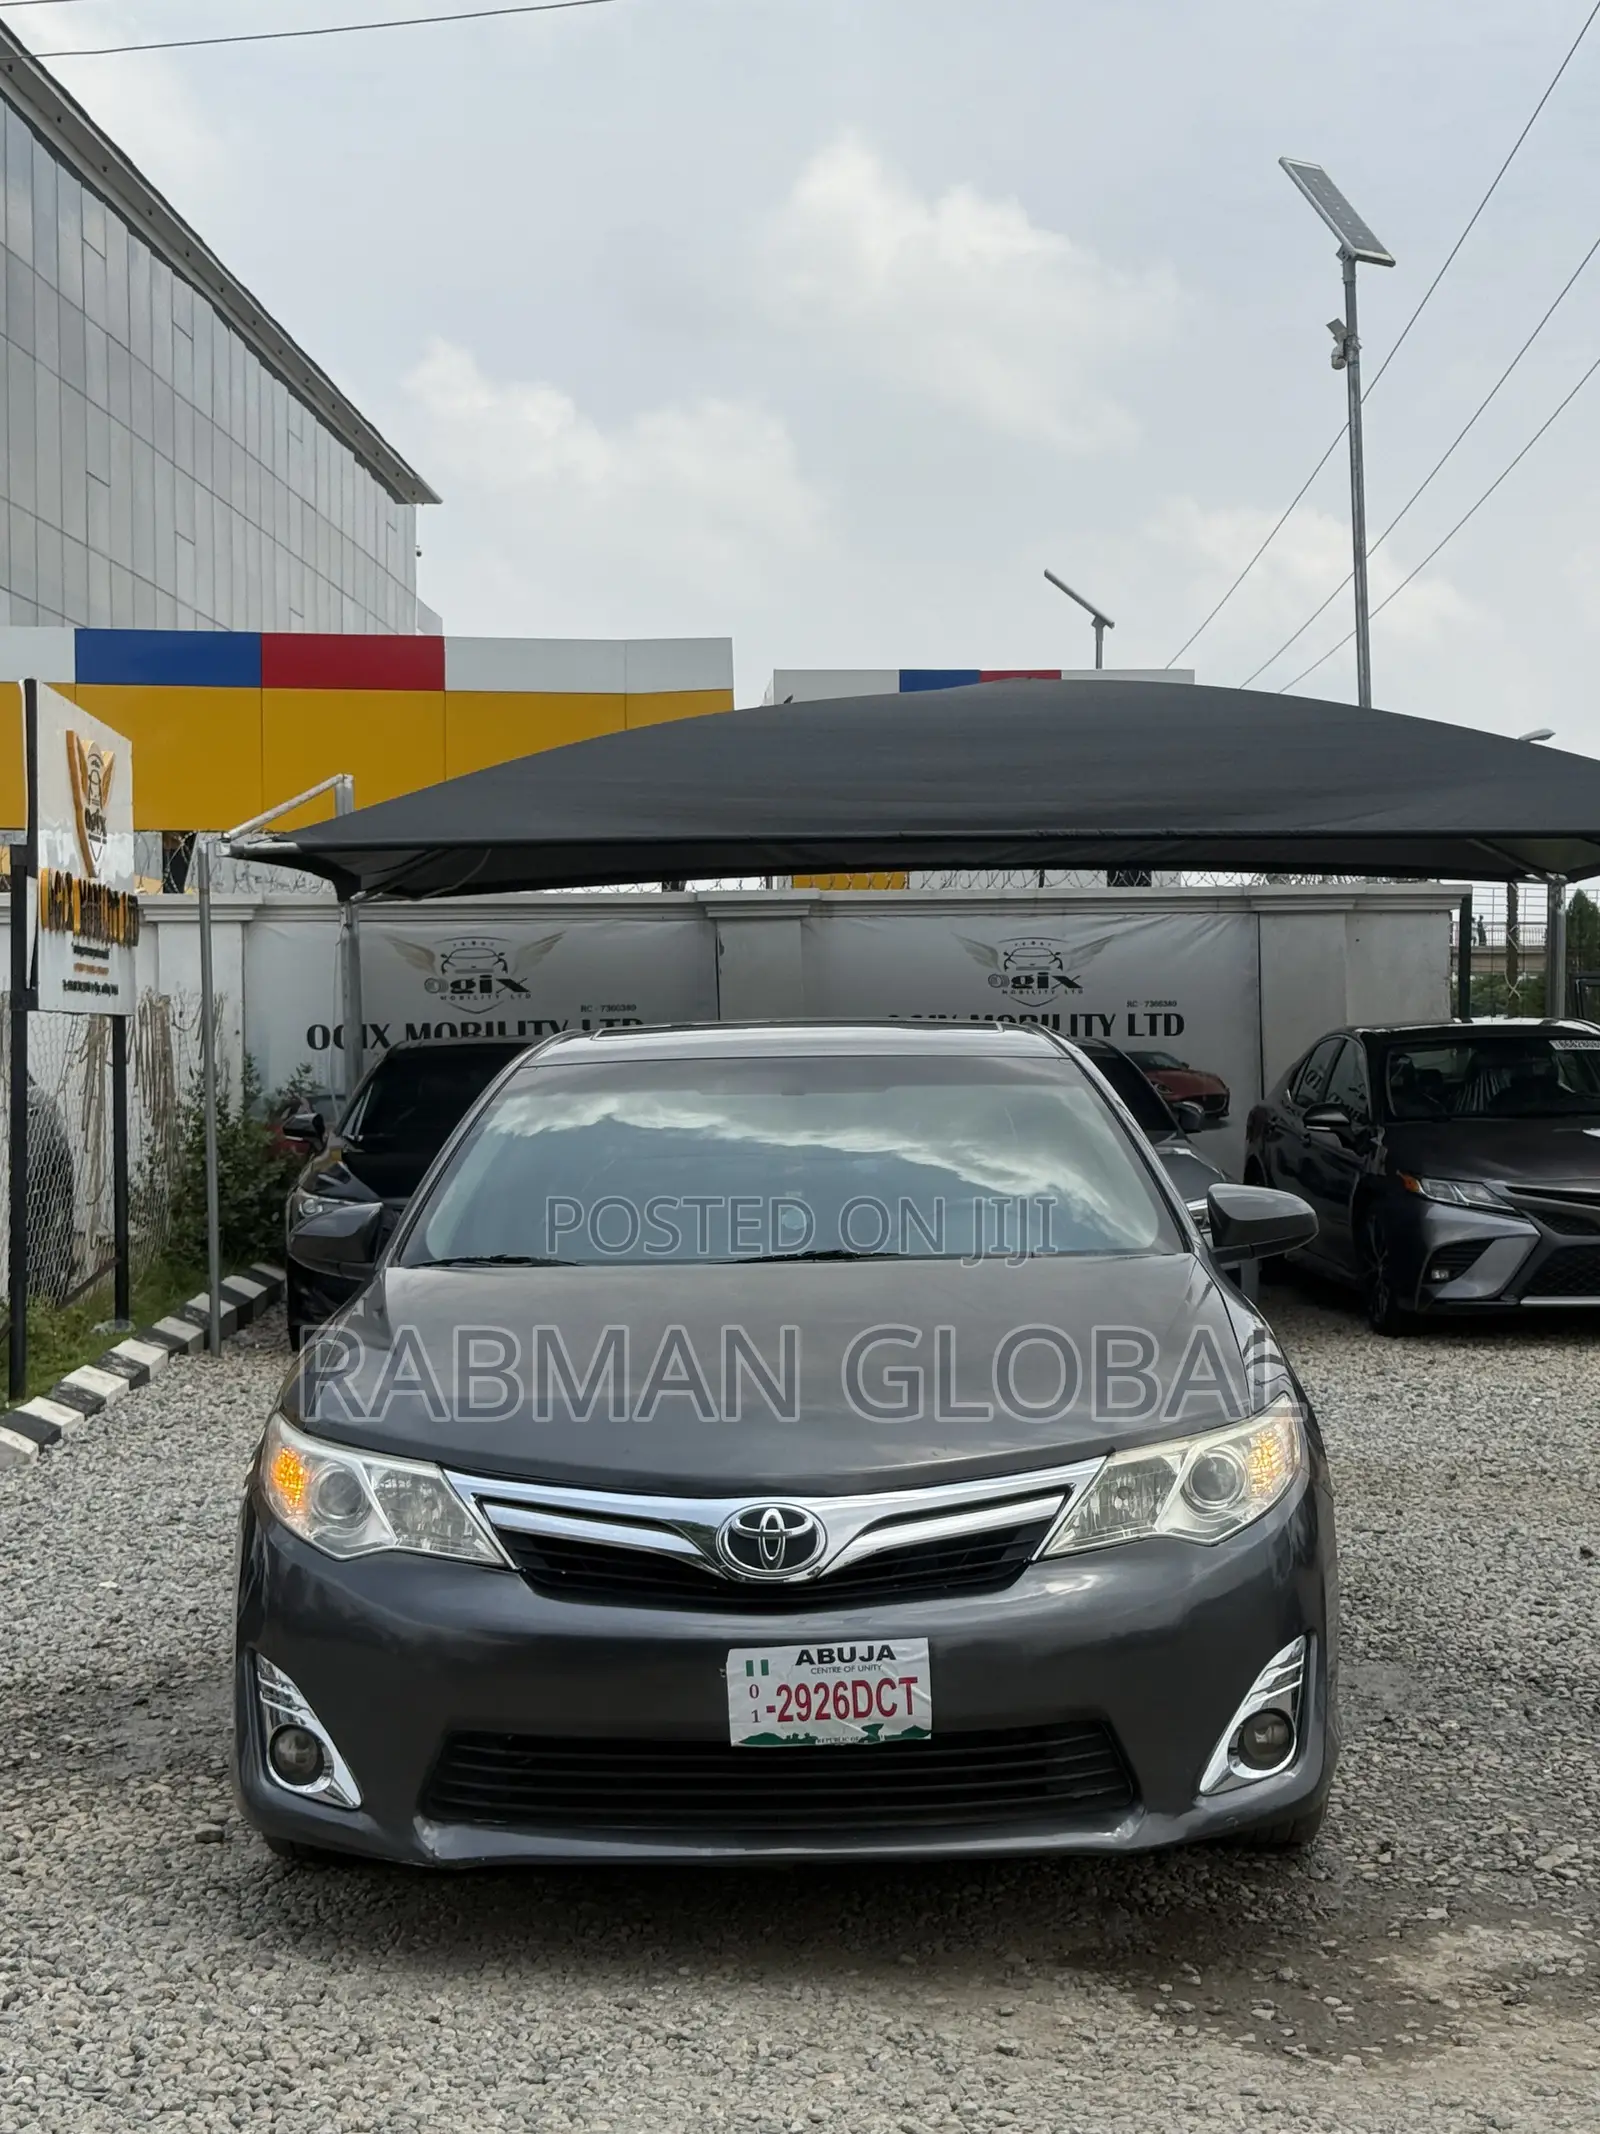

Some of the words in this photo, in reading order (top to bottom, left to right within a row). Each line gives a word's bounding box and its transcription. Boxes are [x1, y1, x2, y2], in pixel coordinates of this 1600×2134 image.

[1127, 1013, 1185, 1037] LTD
[795, 1644, 896, 1666] ABUJA
[811, 1666, 841, 1675] CENTRE
[843, 1665, 856, 1673] OF
[859, 1664, 882, 1673] UNITY
